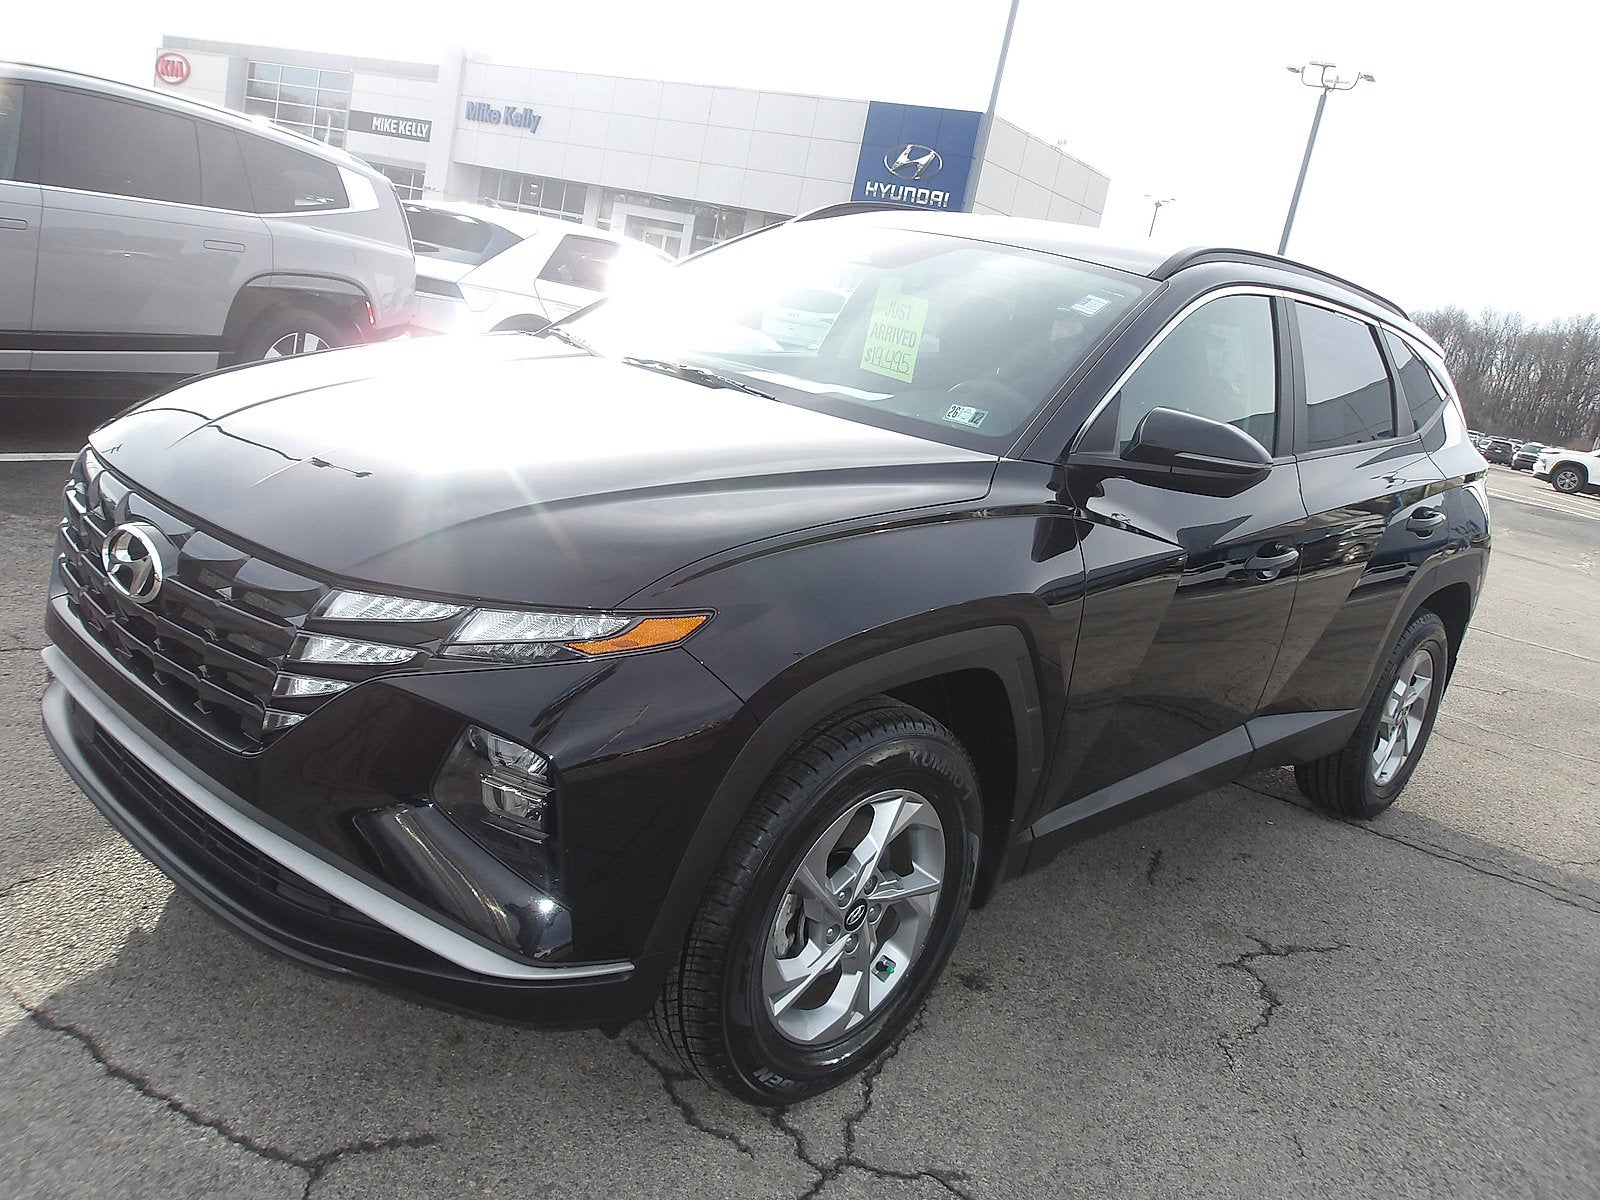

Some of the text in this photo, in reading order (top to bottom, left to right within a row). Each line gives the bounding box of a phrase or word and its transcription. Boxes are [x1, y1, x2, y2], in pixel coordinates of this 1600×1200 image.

[159, 58, 185, 78] KIA
[371, 116, 429, 138] MIKE KELLY
[464, 101, 542, 134] Mike Kelly
[864, 179, 950, 208] HYUNDAI
[884, 300, 914, 321] JUST
[869, 322, 918, 349] ARRIVED
